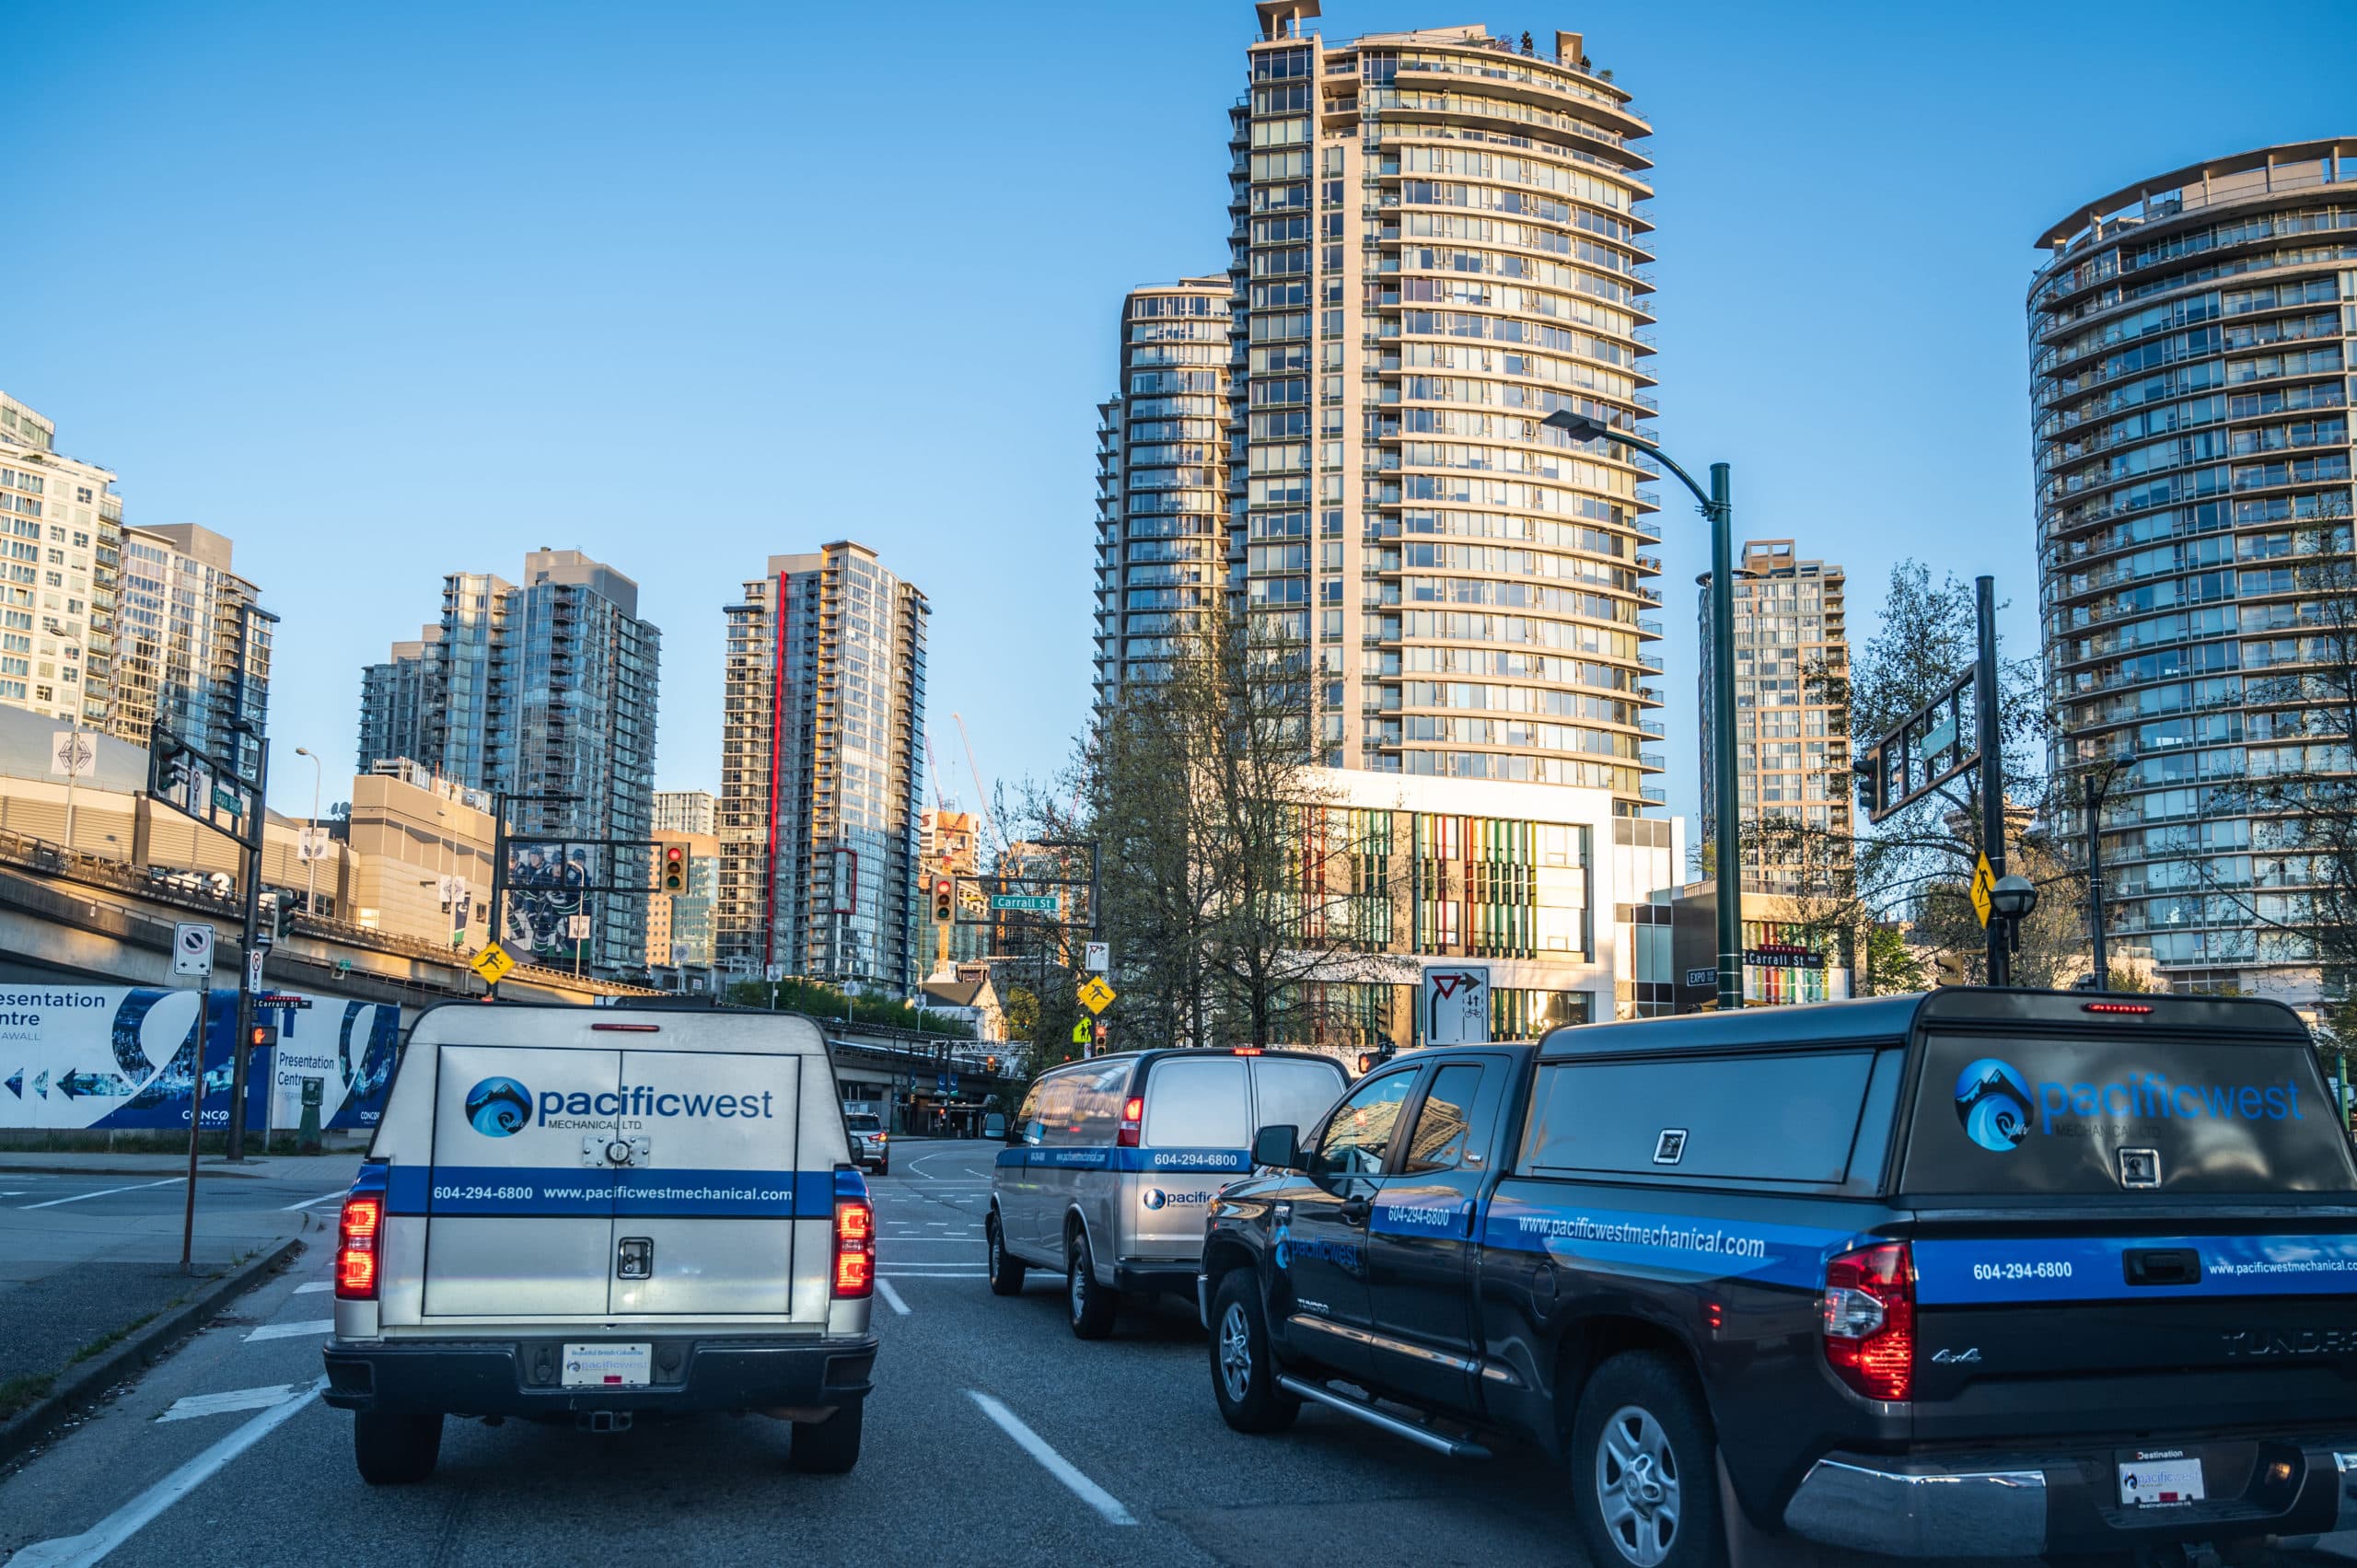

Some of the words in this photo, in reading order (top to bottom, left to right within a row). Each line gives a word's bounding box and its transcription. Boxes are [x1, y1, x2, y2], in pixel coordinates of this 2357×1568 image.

[997, 898, 1036, 908] Carrall
[1039, 899, 1051, 908] St
[1749, 952, 1787, 966] Carrall
[1794, 955, 1804, 966] St
[1689, 971, 1705, 983] EXPO
[279, 1051, 334, 1070] Presentation
[278, 1071, 303, 1086] Centr
[538, 1085, 773, 1127] pacificwest
[2038, 1072, 2304, 1135] pacificwest
[549, 1120, 618, 1130] MECHANICAL
[621, 1121, 643, 1131] LTD.
[1155, 1154, 1237, 1166] 604-294-6800
[434, 1187, 533, 1200] 604-294-6800
[543, 1186, 793, 1202] www.pacificwestmechanical.com
[1388, 1205, 1449, 1226] 604-294-6800
[1519, 1215, 1765, 1258] www.pacificwestmechanical.com
[1291, 1234, 1358, 1267] pacificwest
[1973, 1261, 2072, 1281] 604-294-6800
[2137, 1450, 2184, 1460] Destination
